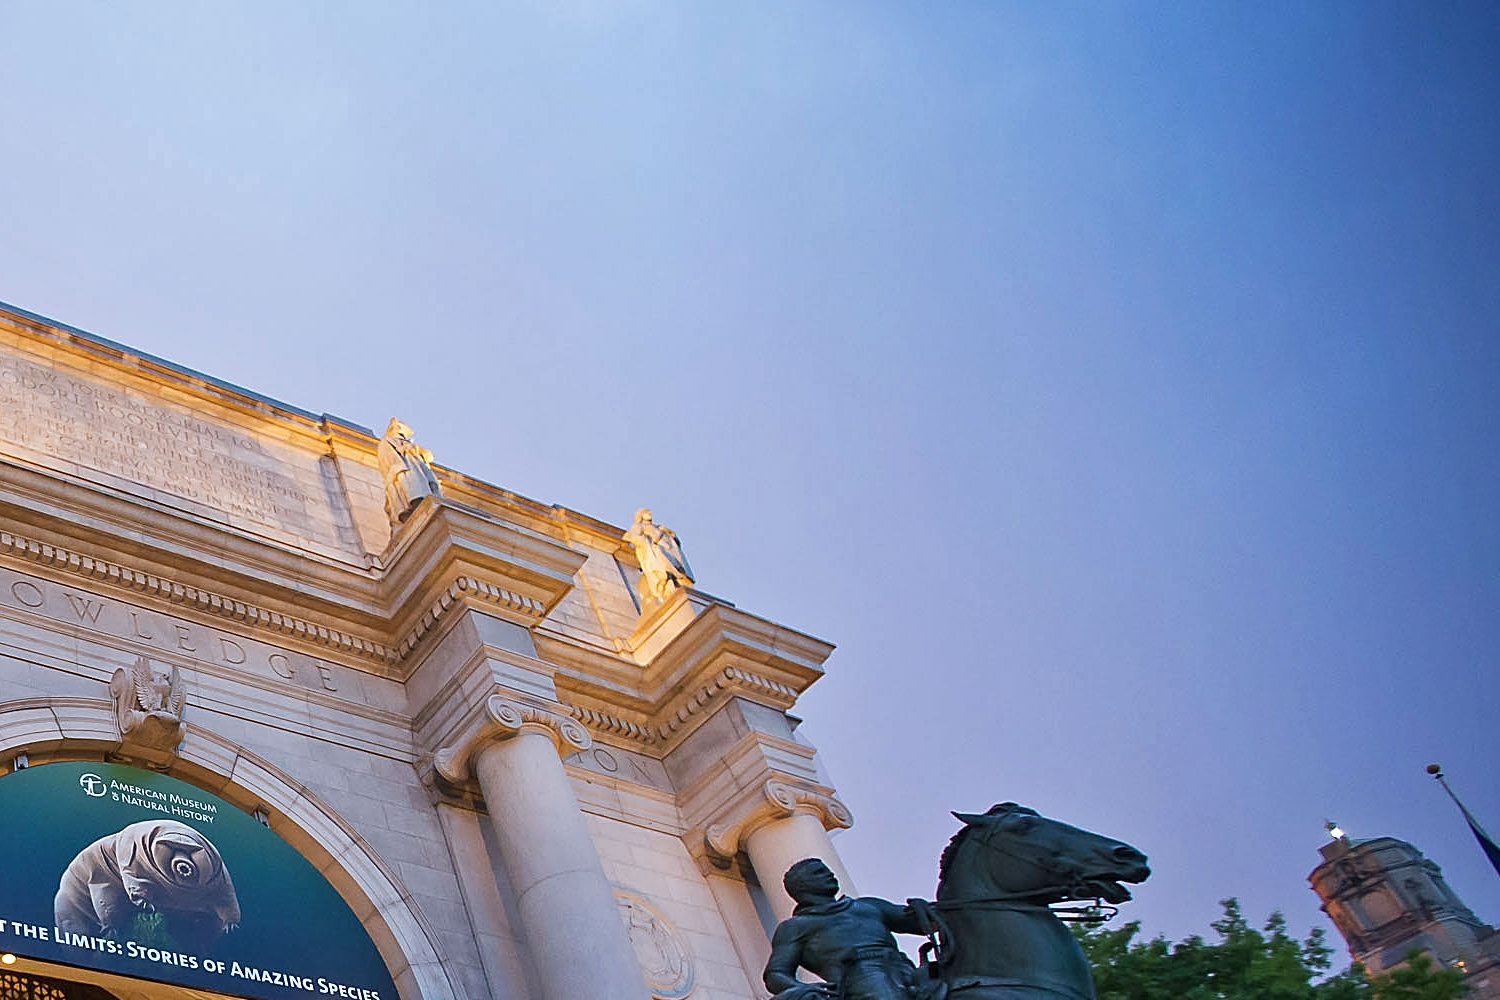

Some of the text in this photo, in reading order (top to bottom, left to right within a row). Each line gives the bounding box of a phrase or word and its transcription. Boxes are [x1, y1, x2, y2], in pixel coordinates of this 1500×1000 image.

[66, 379, 118, 405] YORK
[127, 399, 225, 441] MEMORIAL
[229, 434, 254, 452] TO
[93, 400, 218, 452] ROOSEVELT
[110, 779, 218, 814] AMERICAN MUSEUM
[121, 794, 170, 814] NATURAL
[171, 805, 214, 824] HISTORY
[11, 921, 49, 941] THE
[54, 926, 123, 955] LIMITS:
[126, 941, 199, 970] STORIES
[203, 958, 226, 975] OF
[230, 961, 314, 992] AMAZING
